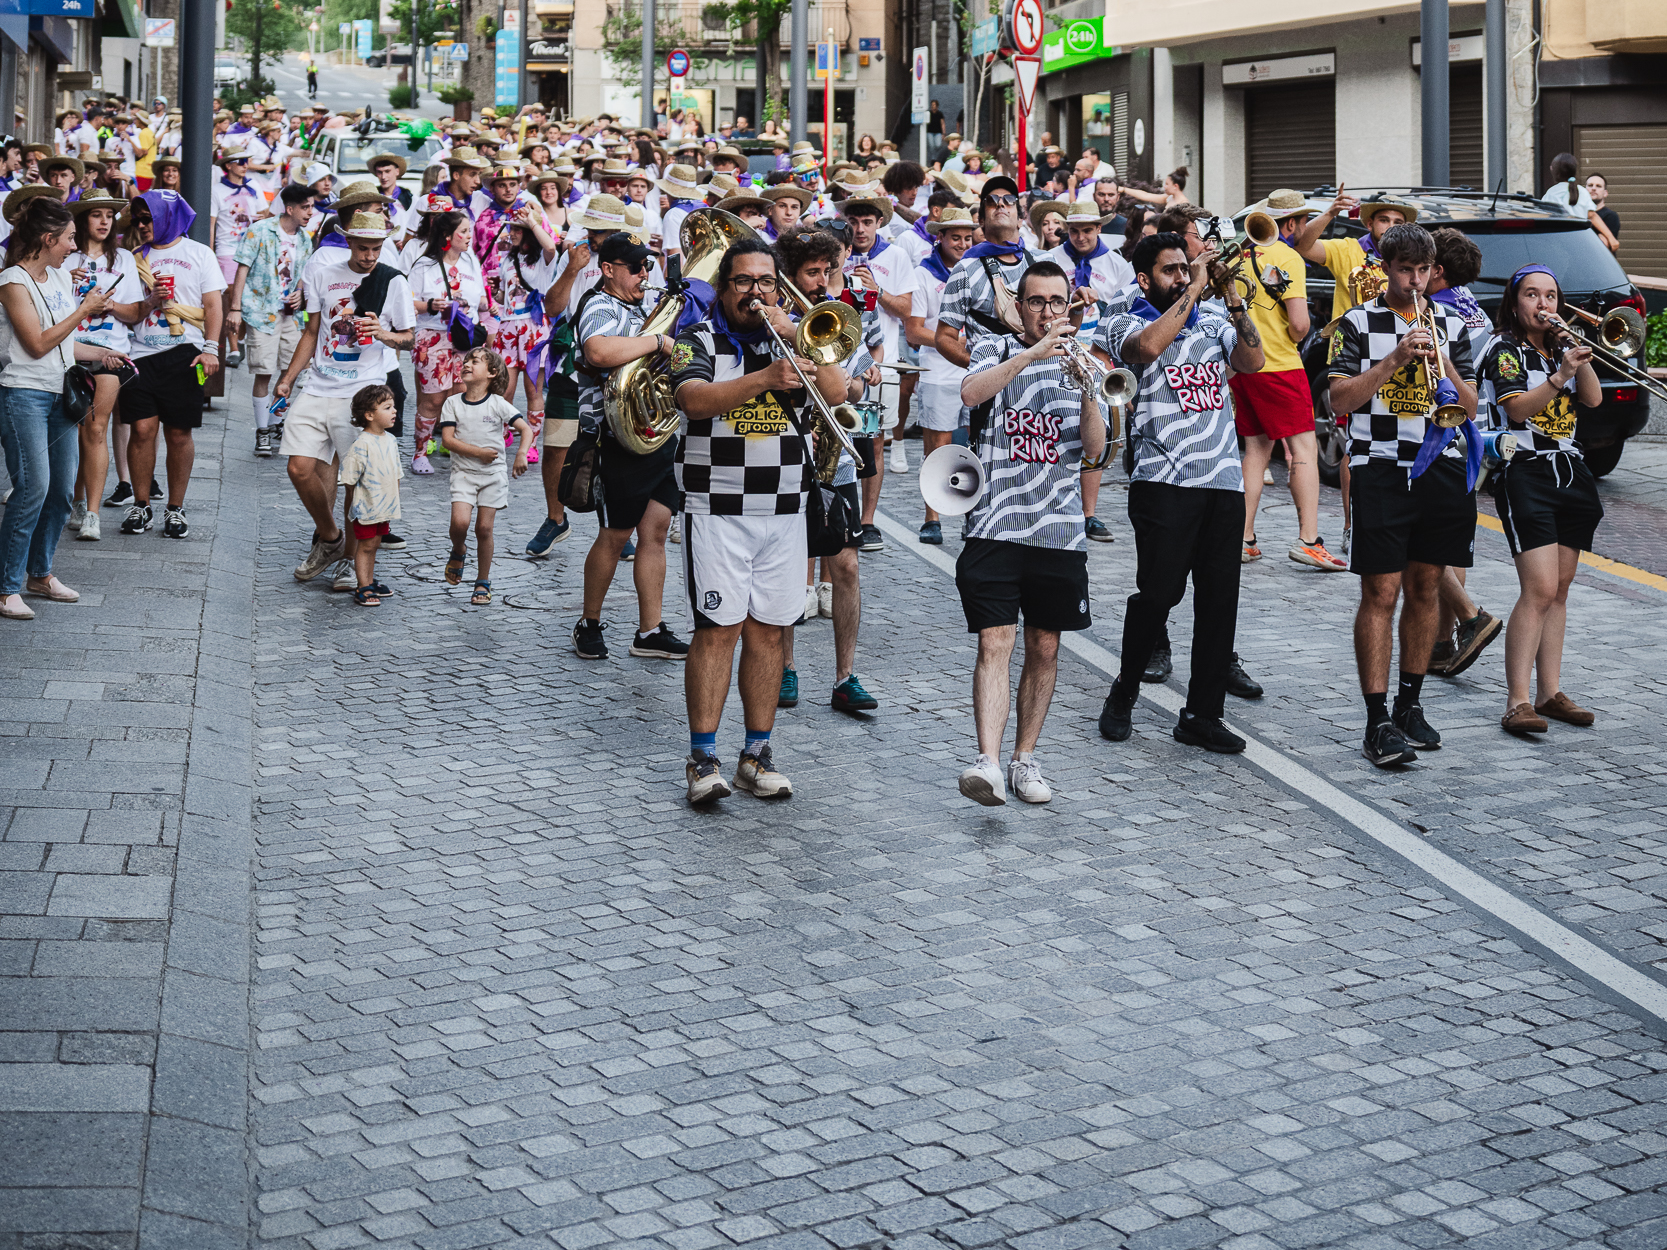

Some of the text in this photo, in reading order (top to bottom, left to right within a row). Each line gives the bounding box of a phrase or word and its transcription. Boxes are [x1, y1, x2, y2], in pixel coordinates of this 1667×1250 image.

[62, 0, 81, 10] 24h
[1070, 30, 1094, 42] 24h
[1163, 360, 1223, 389] BRASS
[1377, 388, 1430, 403] HOOLIGA
[1391, 402, 1429, 414] groove
[719, 409, 788, 421] HOOLIGA
[738, 422, 787, 433] groove
[1003, 407, 1063, 442] BRASS
